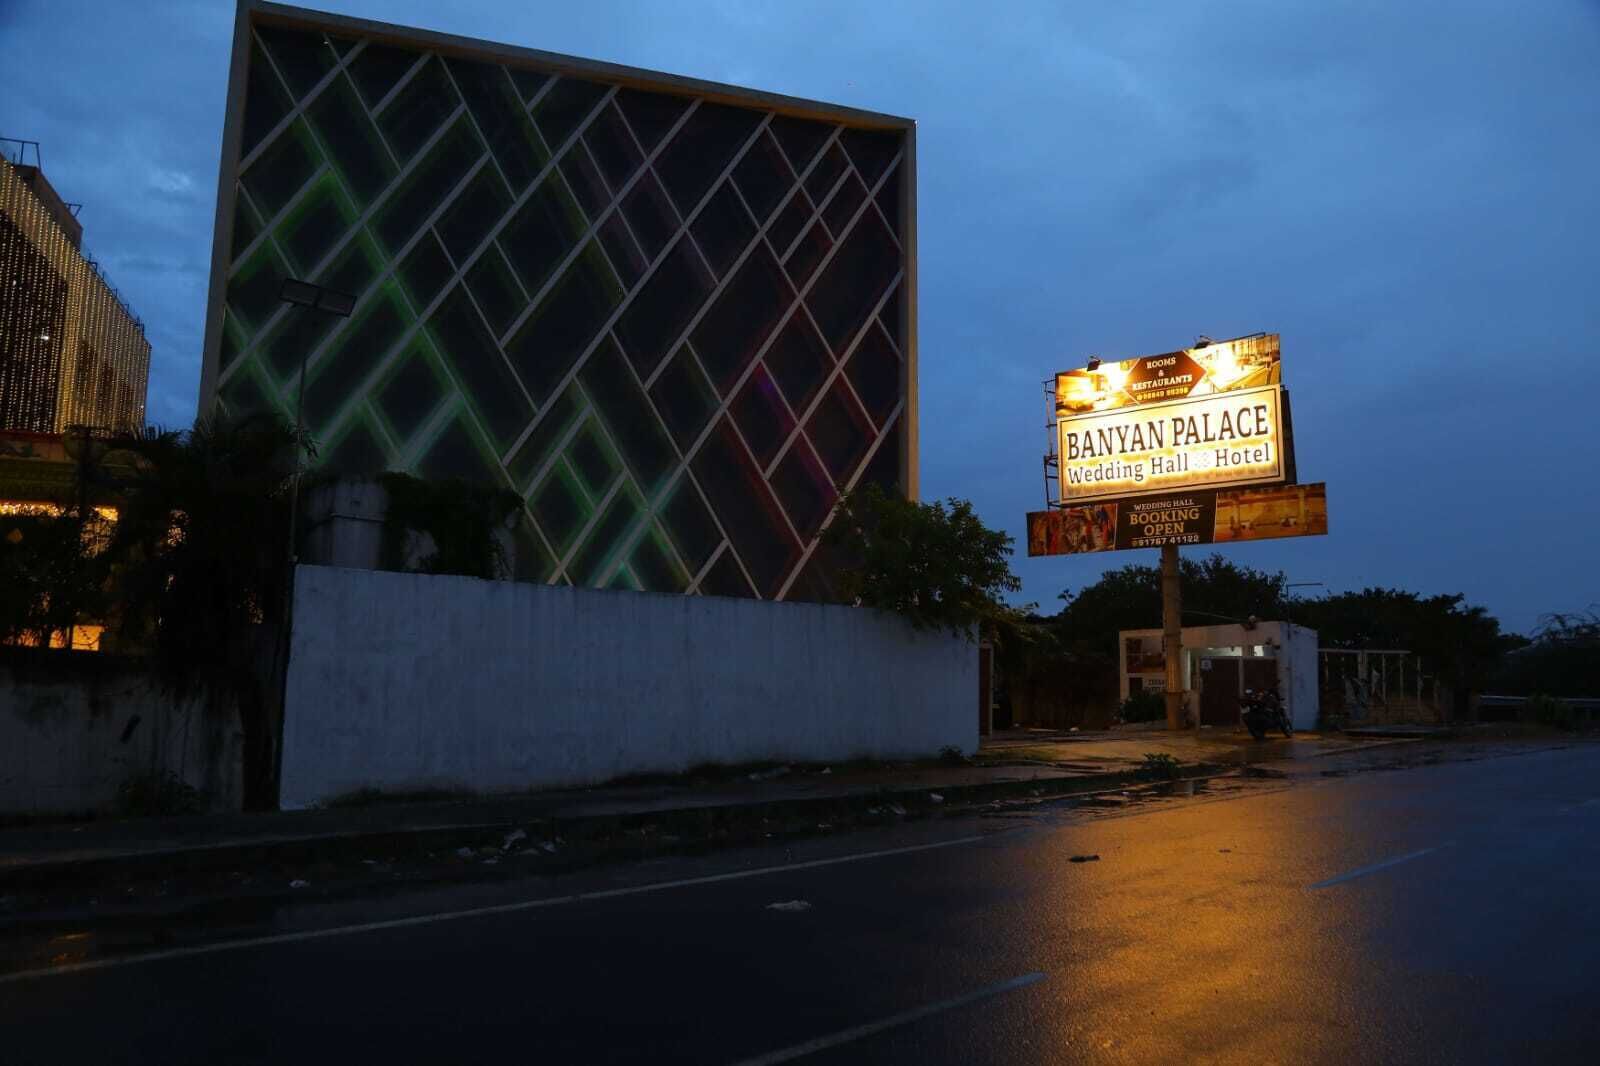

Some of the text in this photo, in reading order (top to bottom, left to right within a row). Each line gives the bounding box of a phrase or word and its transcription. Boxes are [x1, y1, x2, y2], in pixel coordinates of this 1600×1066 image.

[1066, 405, 1268, 460] BANYAN PALACE
[1068, 442, 1270, 484] Wedding Hall Hotel
[1134, 498, 1195, 511] WEDDING HALL
[1129, 508, 1200, 525] BOOKING
[1144, 521, 1184, 536] OPEN
